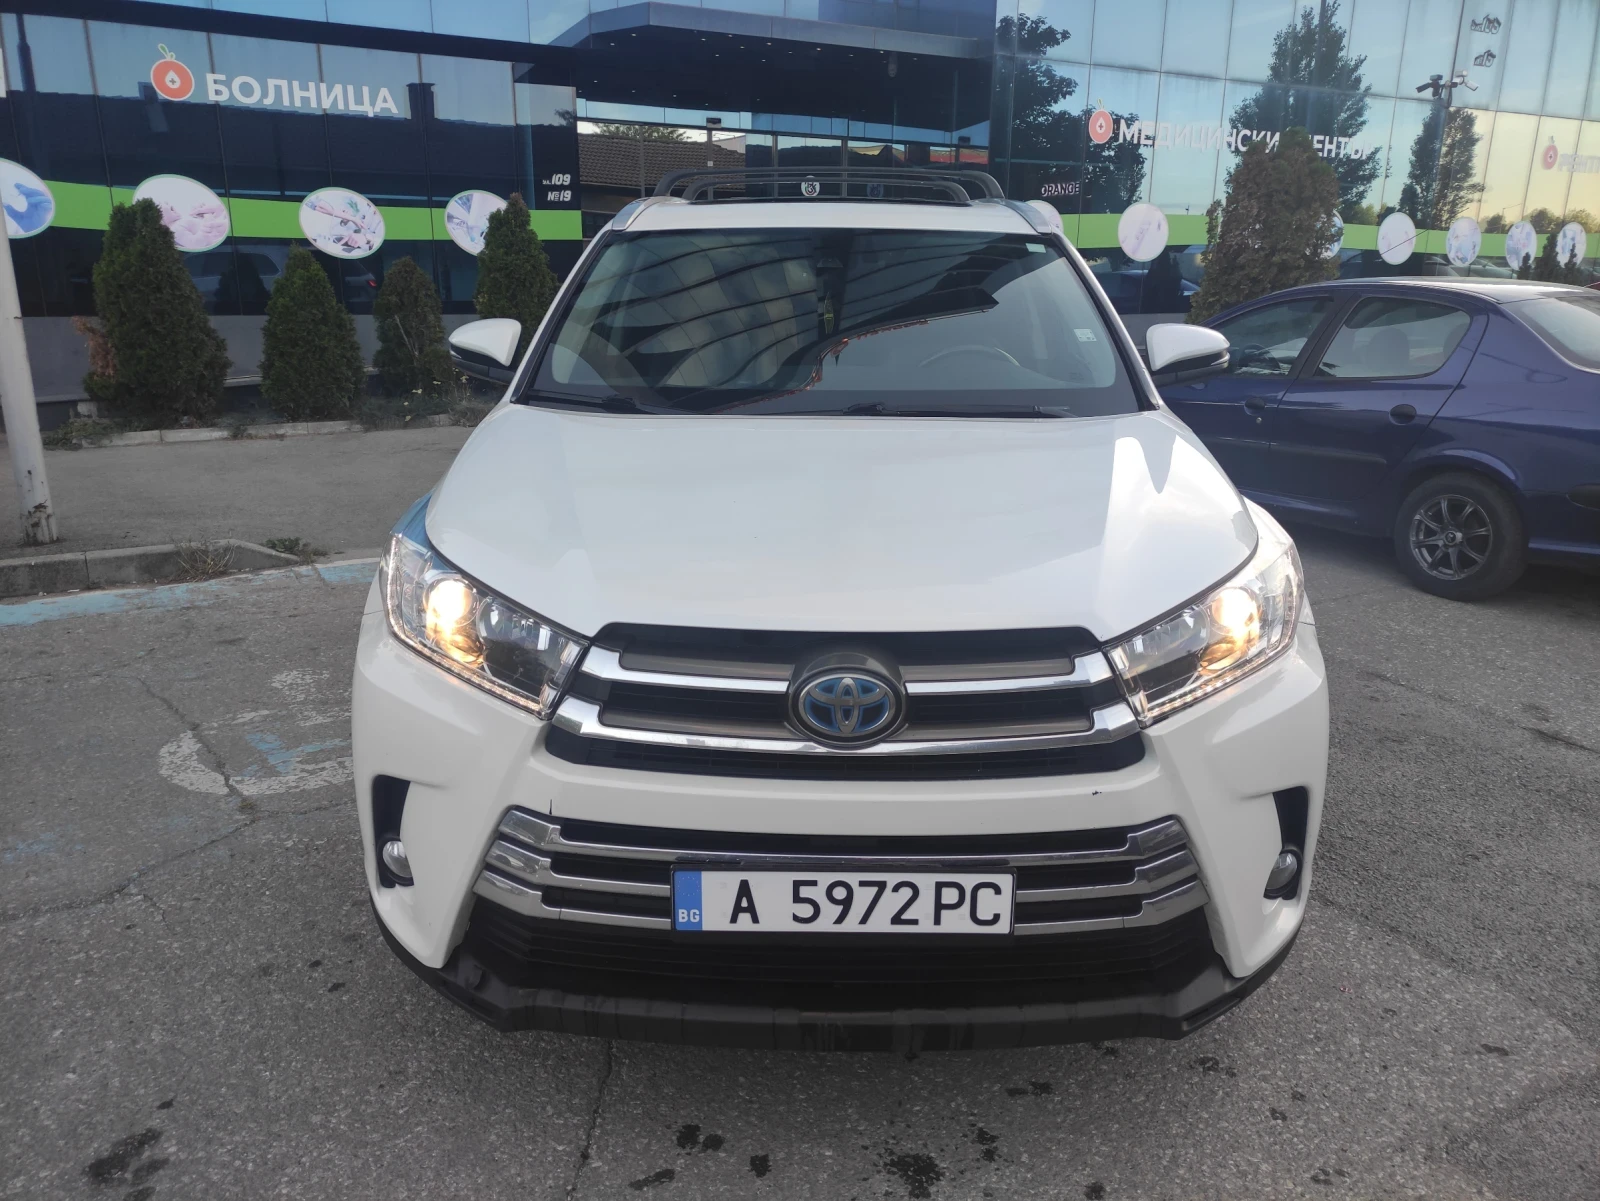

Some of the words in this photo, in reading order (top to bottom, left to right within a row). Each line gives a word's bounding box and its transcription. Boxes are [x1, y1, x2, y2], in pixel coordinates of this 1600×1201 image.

[205, 73, 399, 117] БОЛНИЦА
[1118, 118, 1281, 153] МЕДИЦИНСКИ
[1308, 133, 1372, 160] ЕНТЪР
[1041, 181, 1080, 197] ORANGE
[677, 908, 700, 923] BG
[729, 878, 760, 925] A
